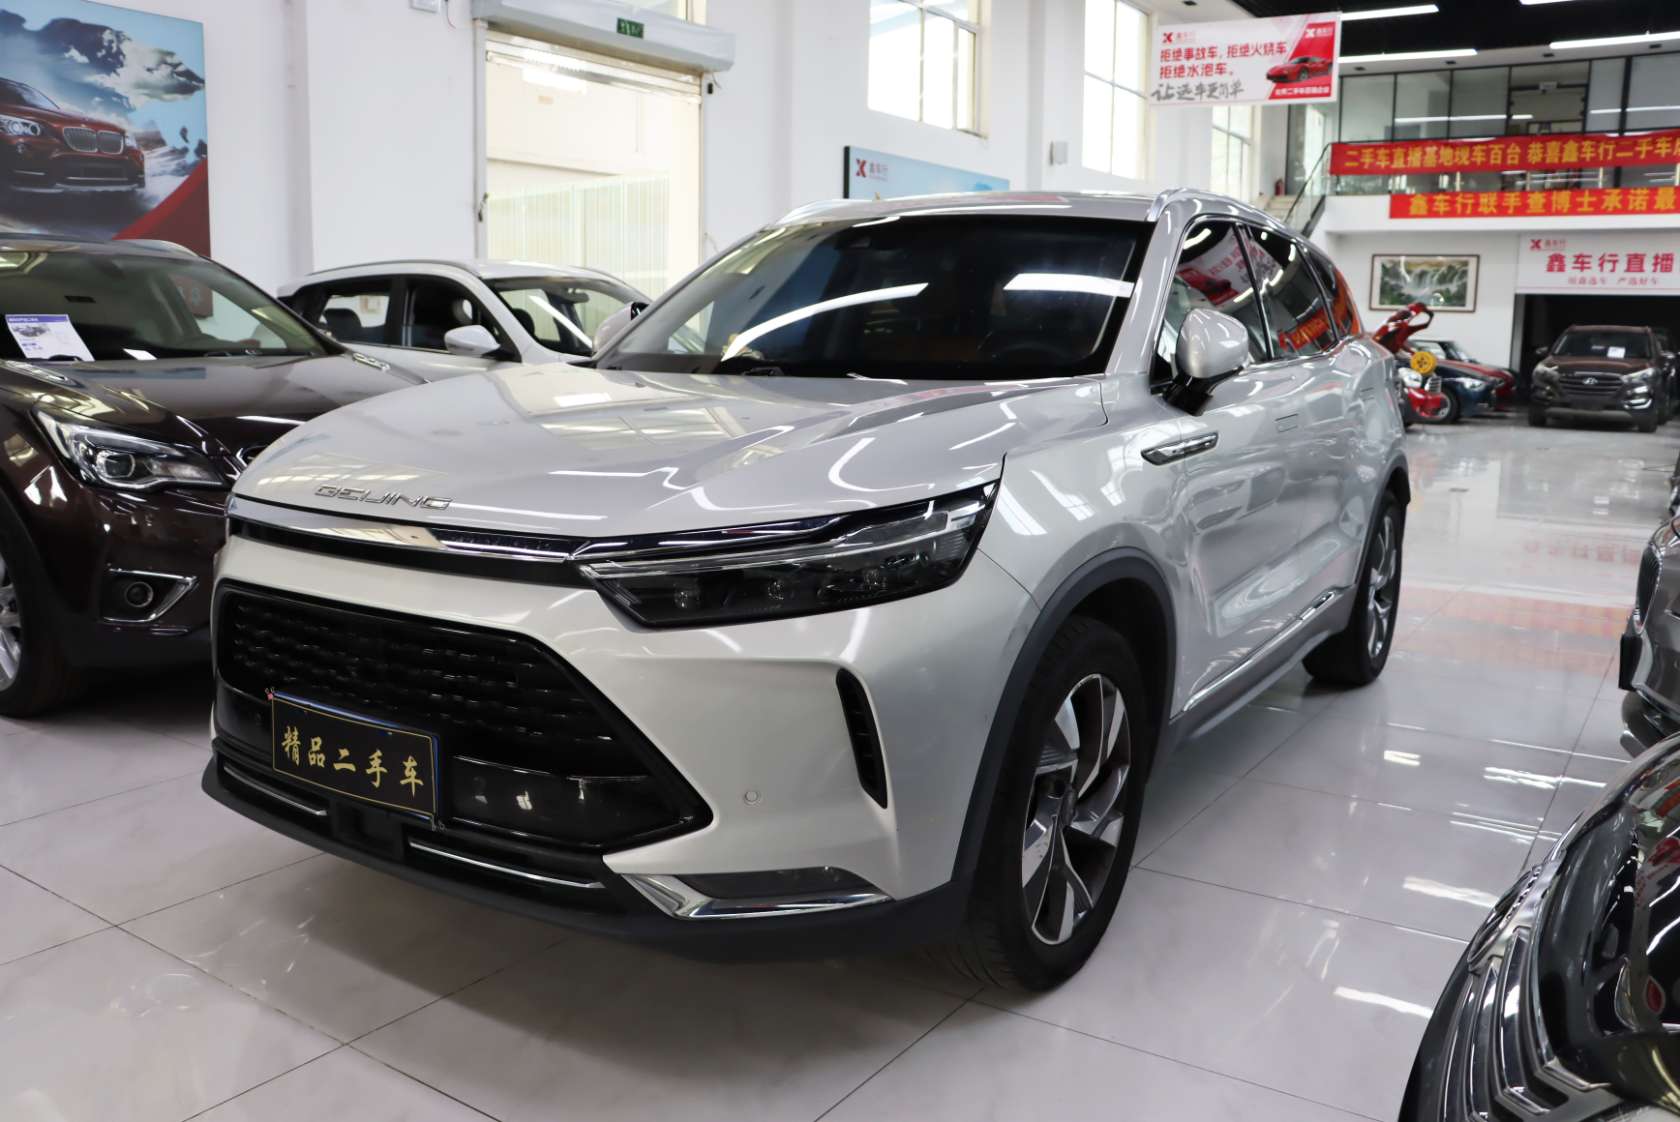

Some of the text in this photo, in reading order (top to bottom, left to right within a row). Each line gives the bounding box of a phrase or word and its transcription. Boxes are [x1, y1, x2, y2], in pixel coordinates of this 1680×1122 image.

[1344, 143, 1521, 169] 二手车直播基地现车百台
[1409, 187, 1676, 215] 鑫车行联手查博士承诺最
[1546, 252, 1675, 273] 鑫车行直播
[314, 483, 454, 511] BEIJING
[281, 725, 424, 798] 精品二手车
